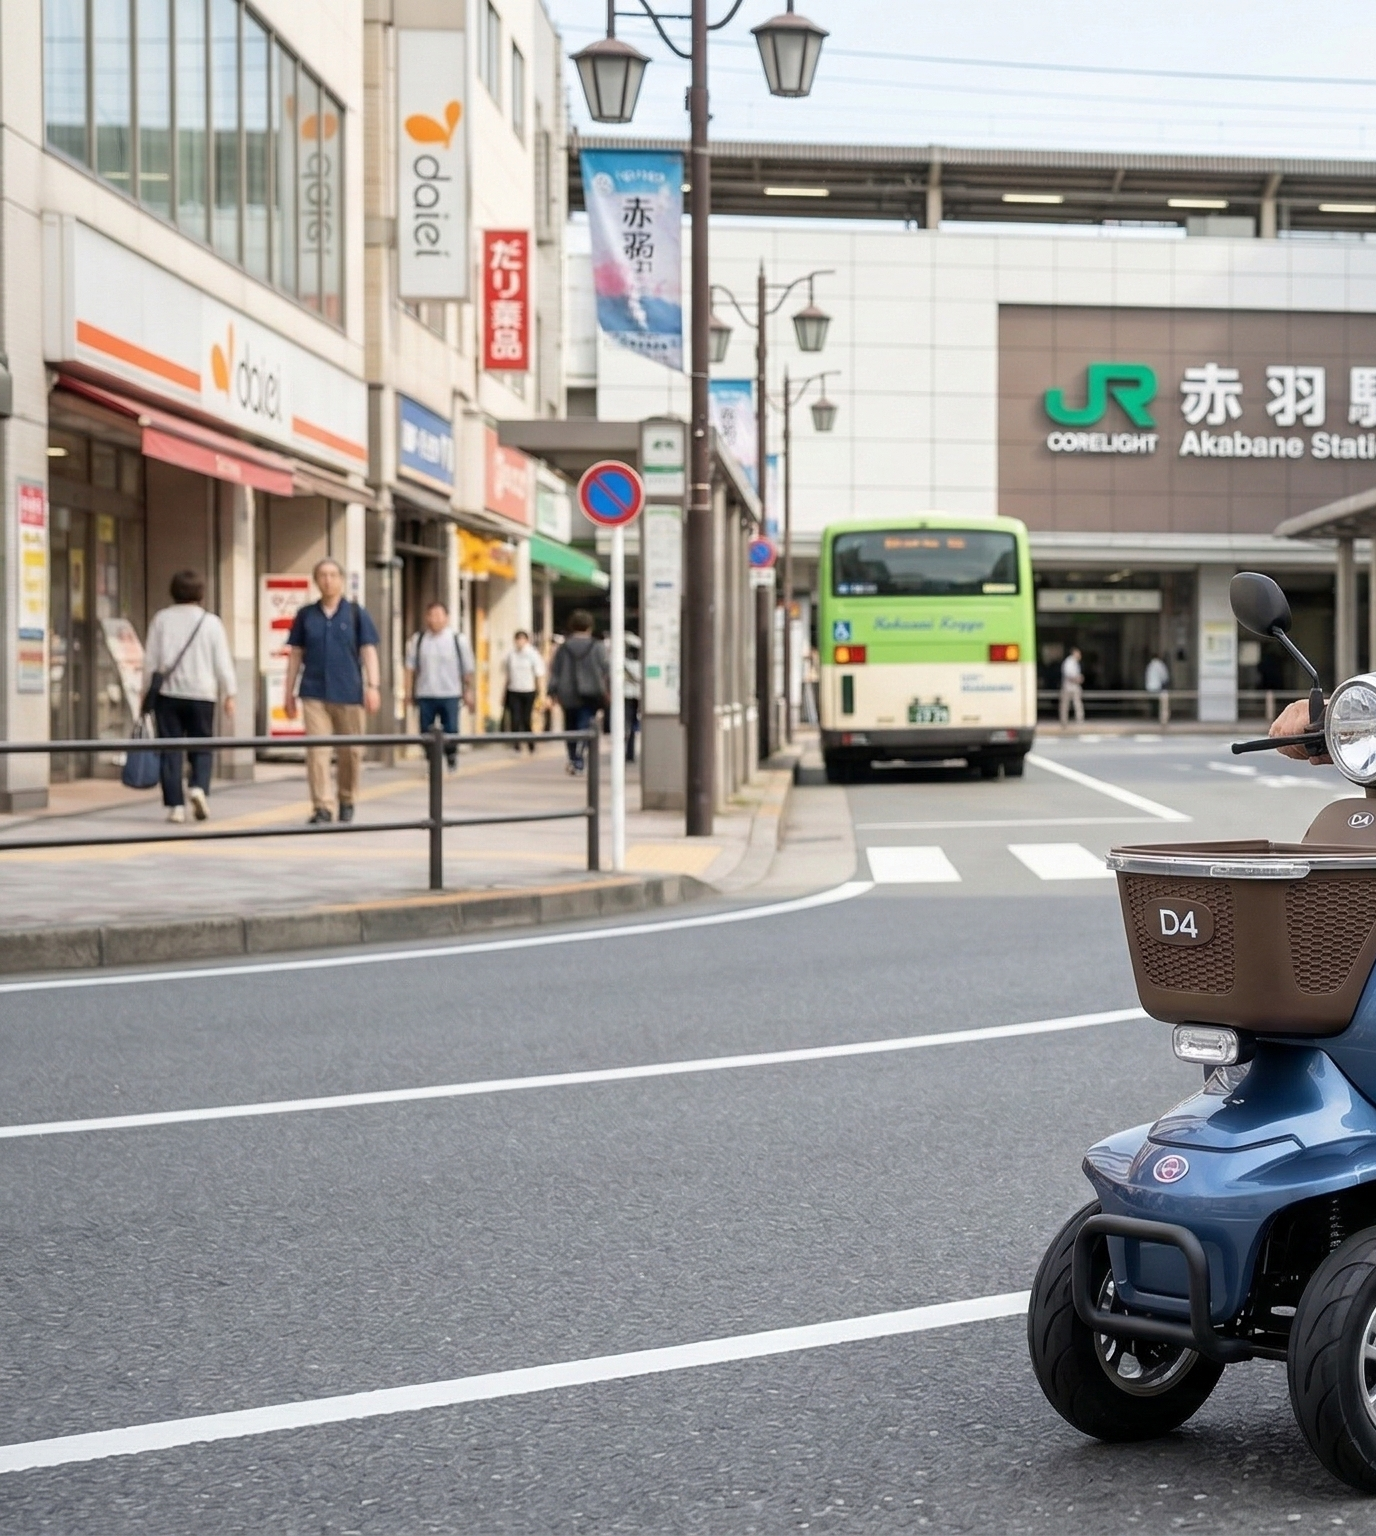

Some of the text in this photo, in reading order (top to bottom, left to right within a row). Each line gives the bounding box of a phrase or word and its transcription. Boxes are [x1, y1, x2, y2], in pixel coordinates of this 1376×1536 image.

[413, 154, 451, 257] daiei
[237, 342, 282, 422] daiei
[1044, 361, 1158, 427] JR
[1179, 430, 1305, 459] Akabane
[1159, 908, 1198, 938] D4
